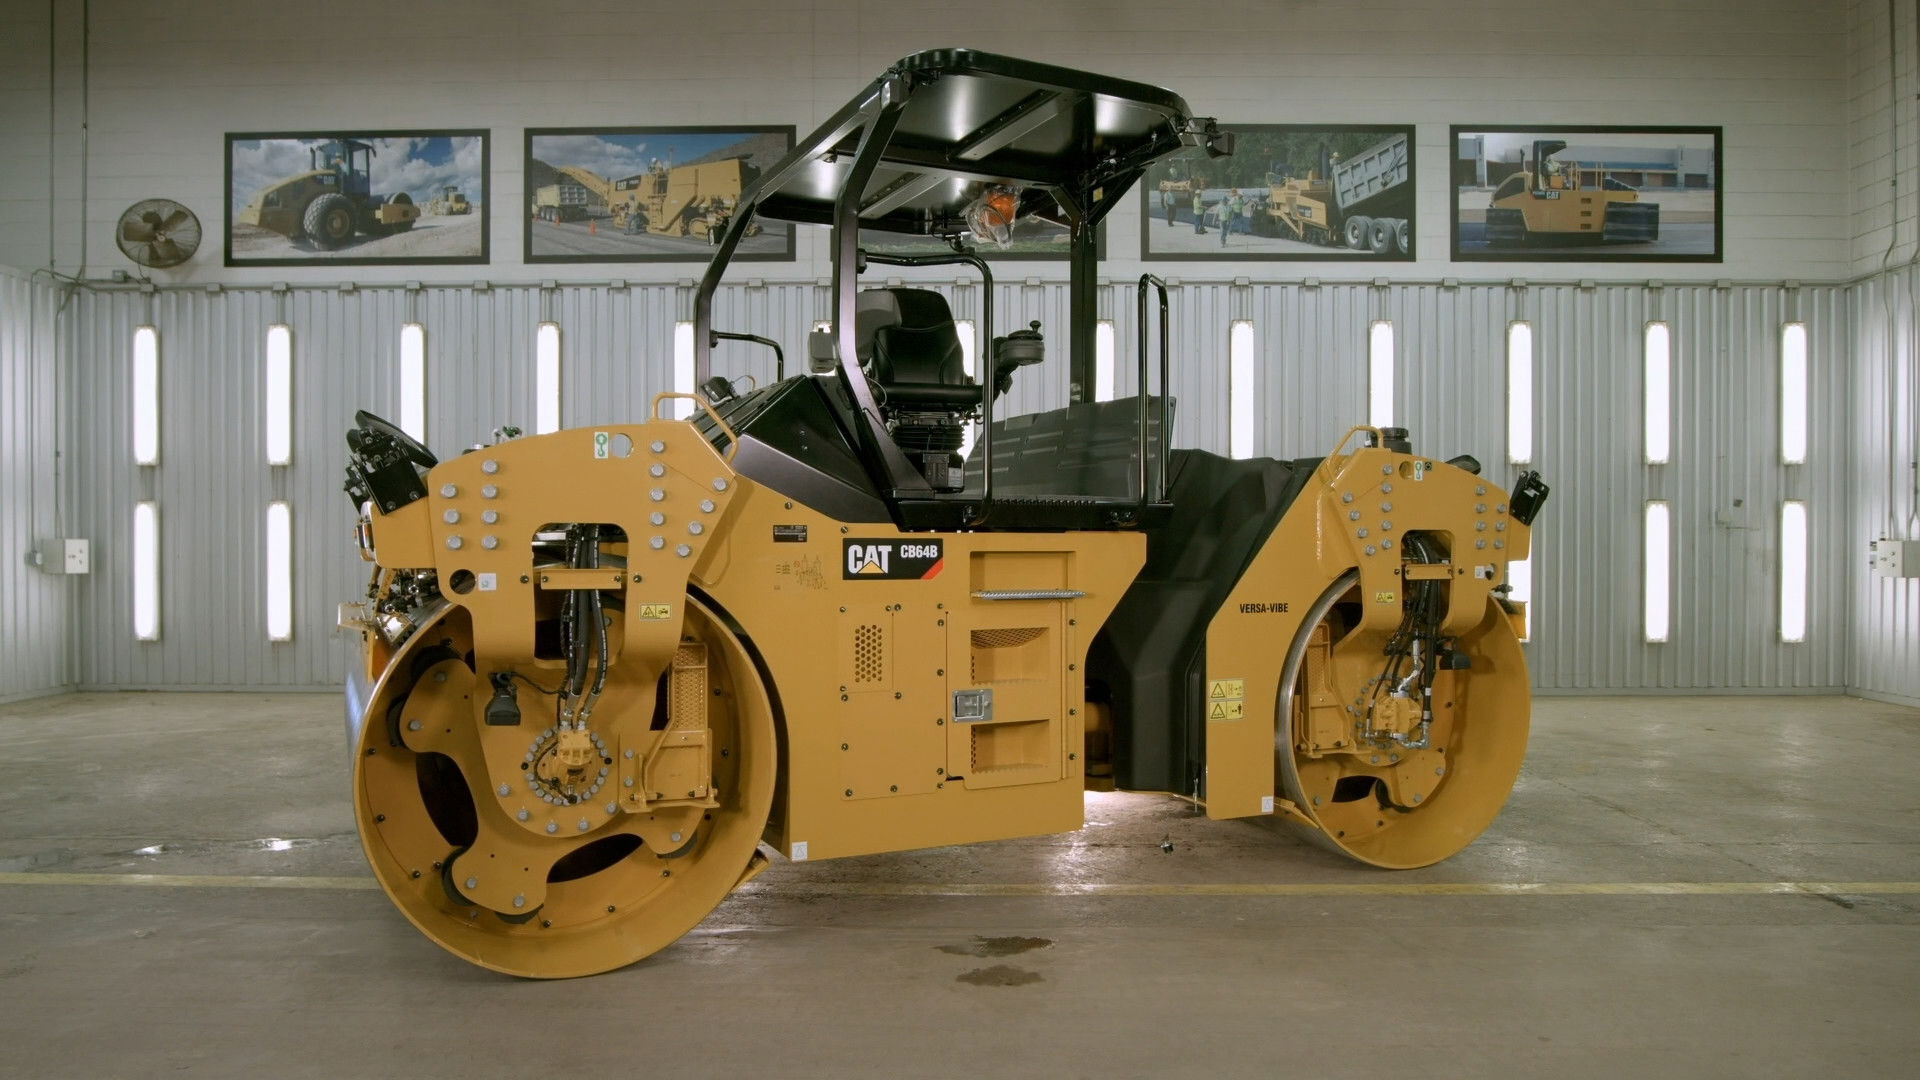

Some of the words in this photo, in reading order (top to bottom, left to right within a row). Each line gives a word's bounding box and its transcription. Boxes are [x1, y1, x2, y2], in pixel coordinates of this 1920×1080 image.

[1546, 191, 1559, 200] CAT
[848, 544, 892, 574] CAT
[900, 544, 938, 559] CB64B
[1239, 602, 1289, 614] VERSA-VIBE
